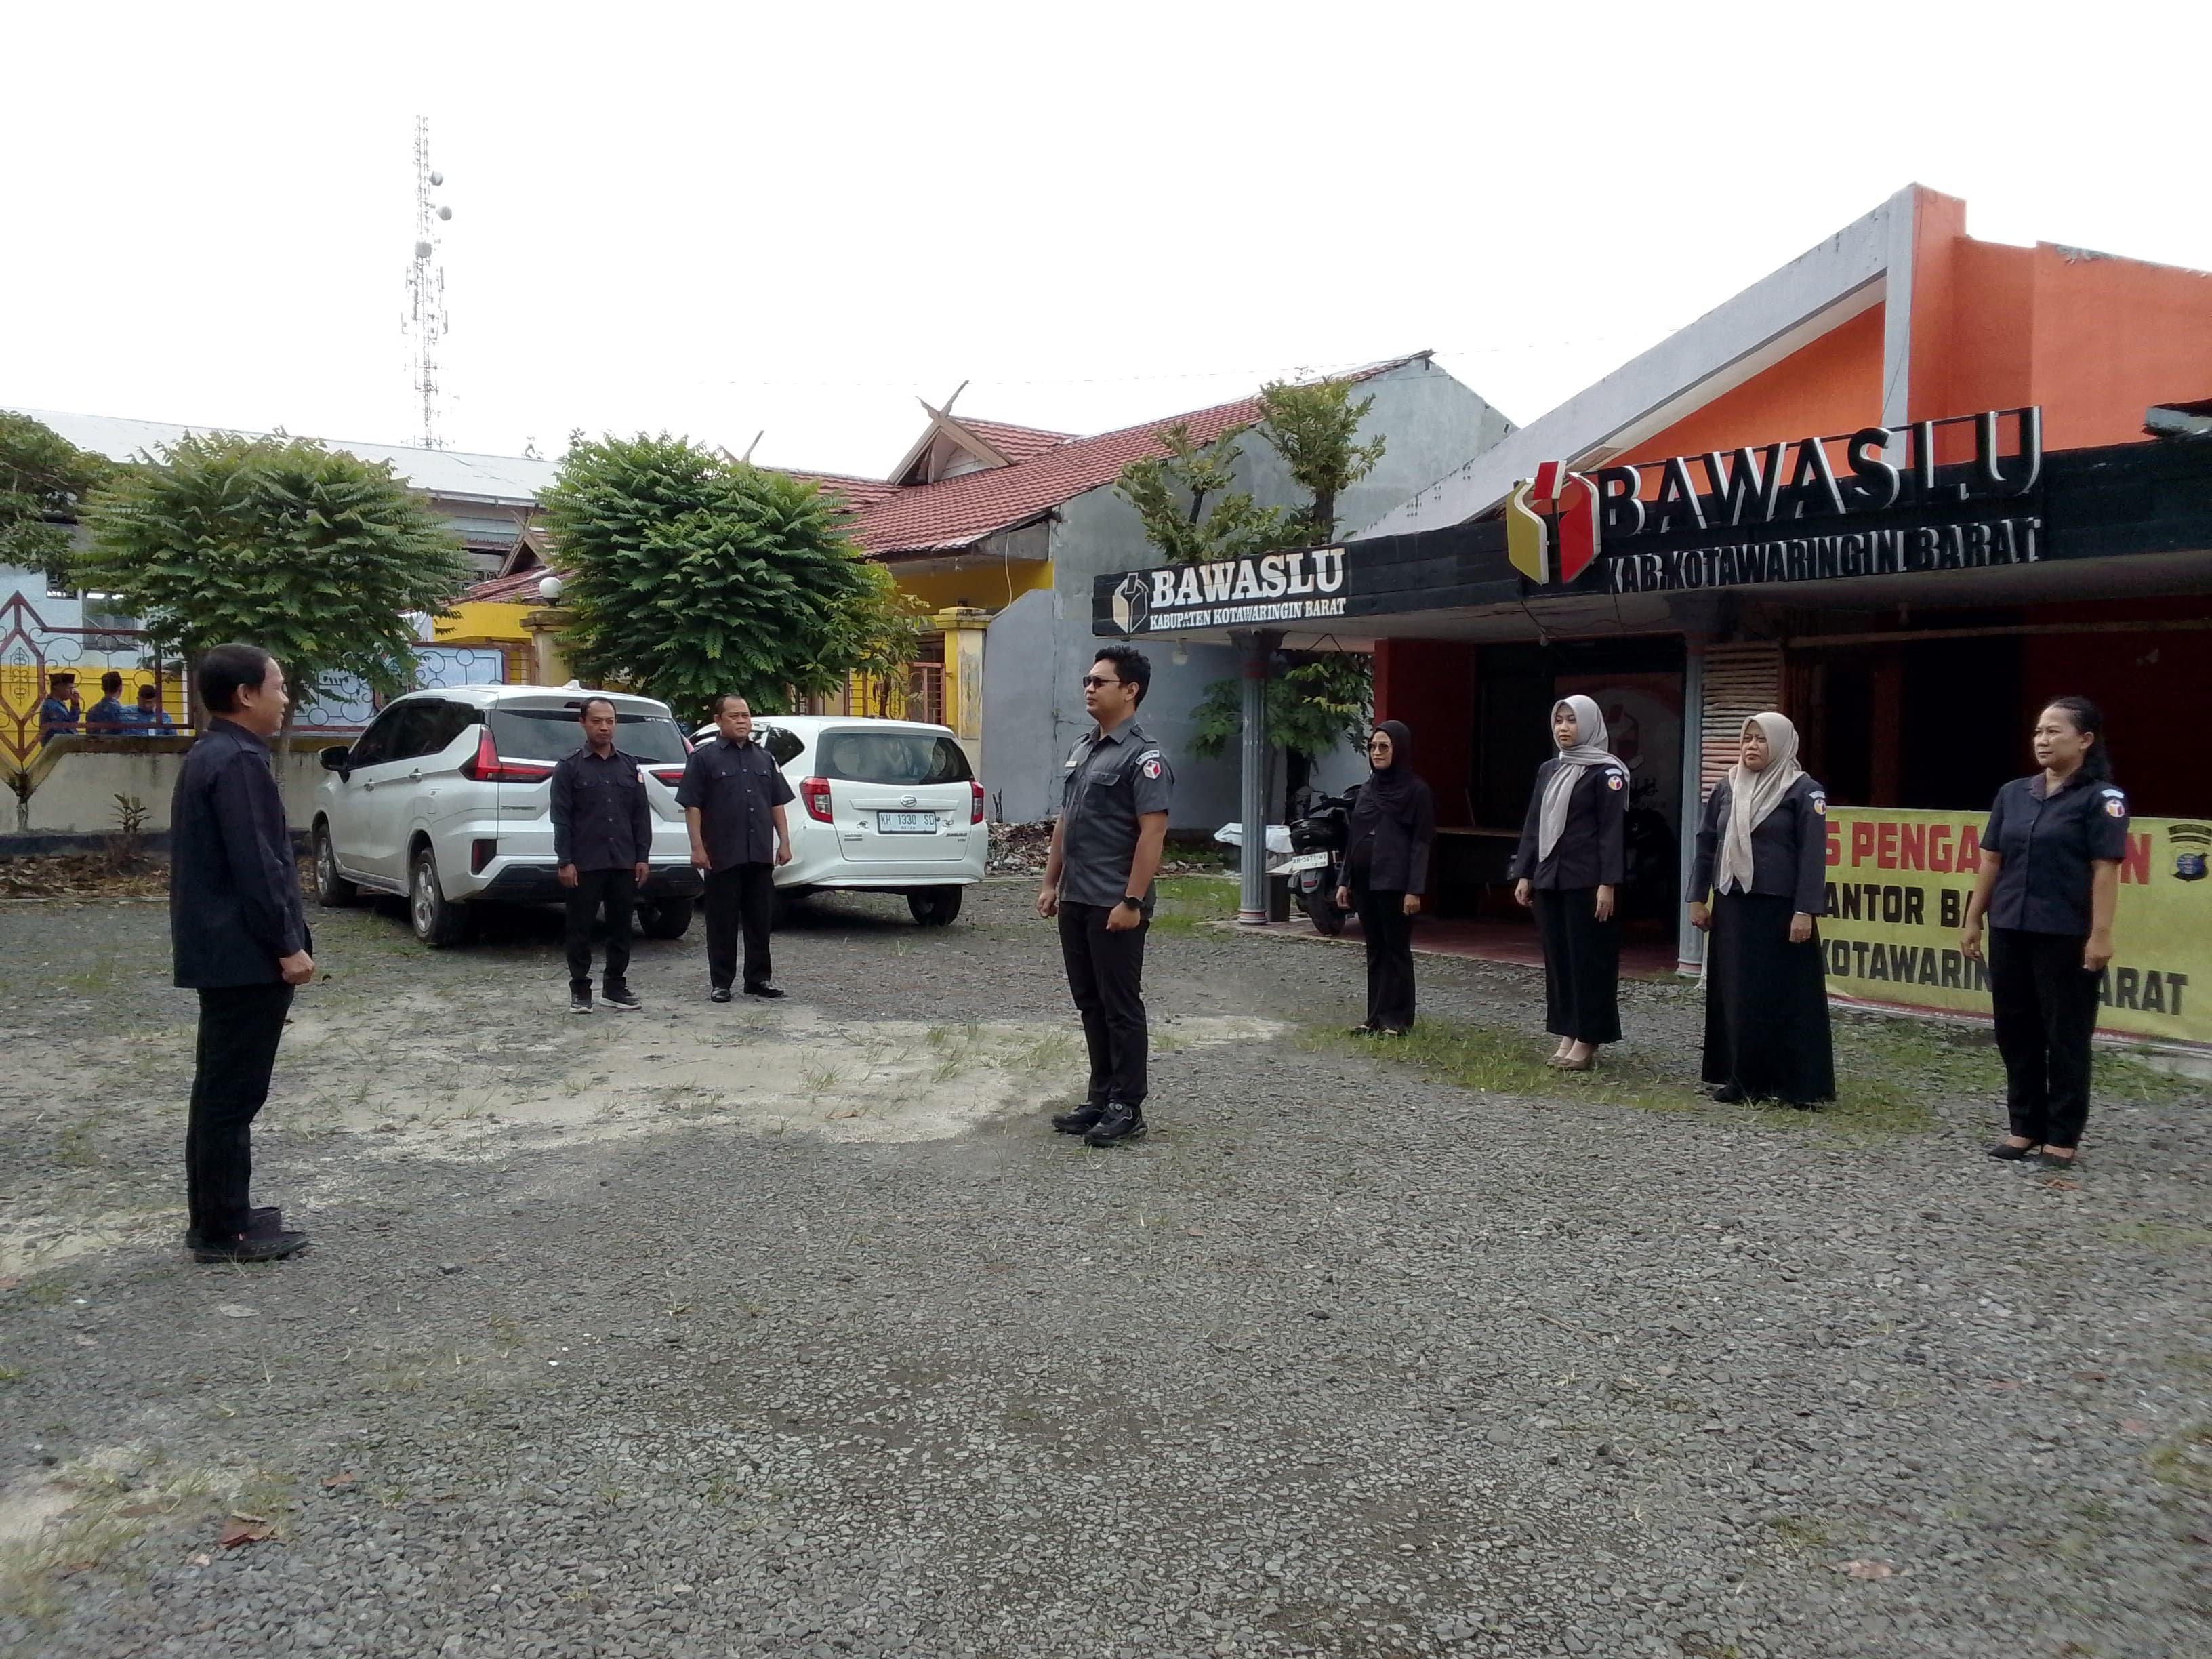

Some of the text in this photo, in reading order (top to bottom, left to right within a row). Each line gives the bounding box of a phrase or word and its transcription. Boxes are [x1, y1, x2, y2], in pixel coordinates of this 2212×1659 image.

[1597, 406, 2042, 537] BAWASLU
[1914, 516, 2041, 570] BARAT
[1150, 548, 1345, 609] BAWASLU
[1150, 598, 1346, 631] KABUPATEN KOTAWARINGIN BARAT
[881, 814, 891, 825] KH
[898, 814, 916, 825] 1330
[1822, 882, 1925, 925] ANTOR
[2098, 965, 2189, 1015] ARAT
